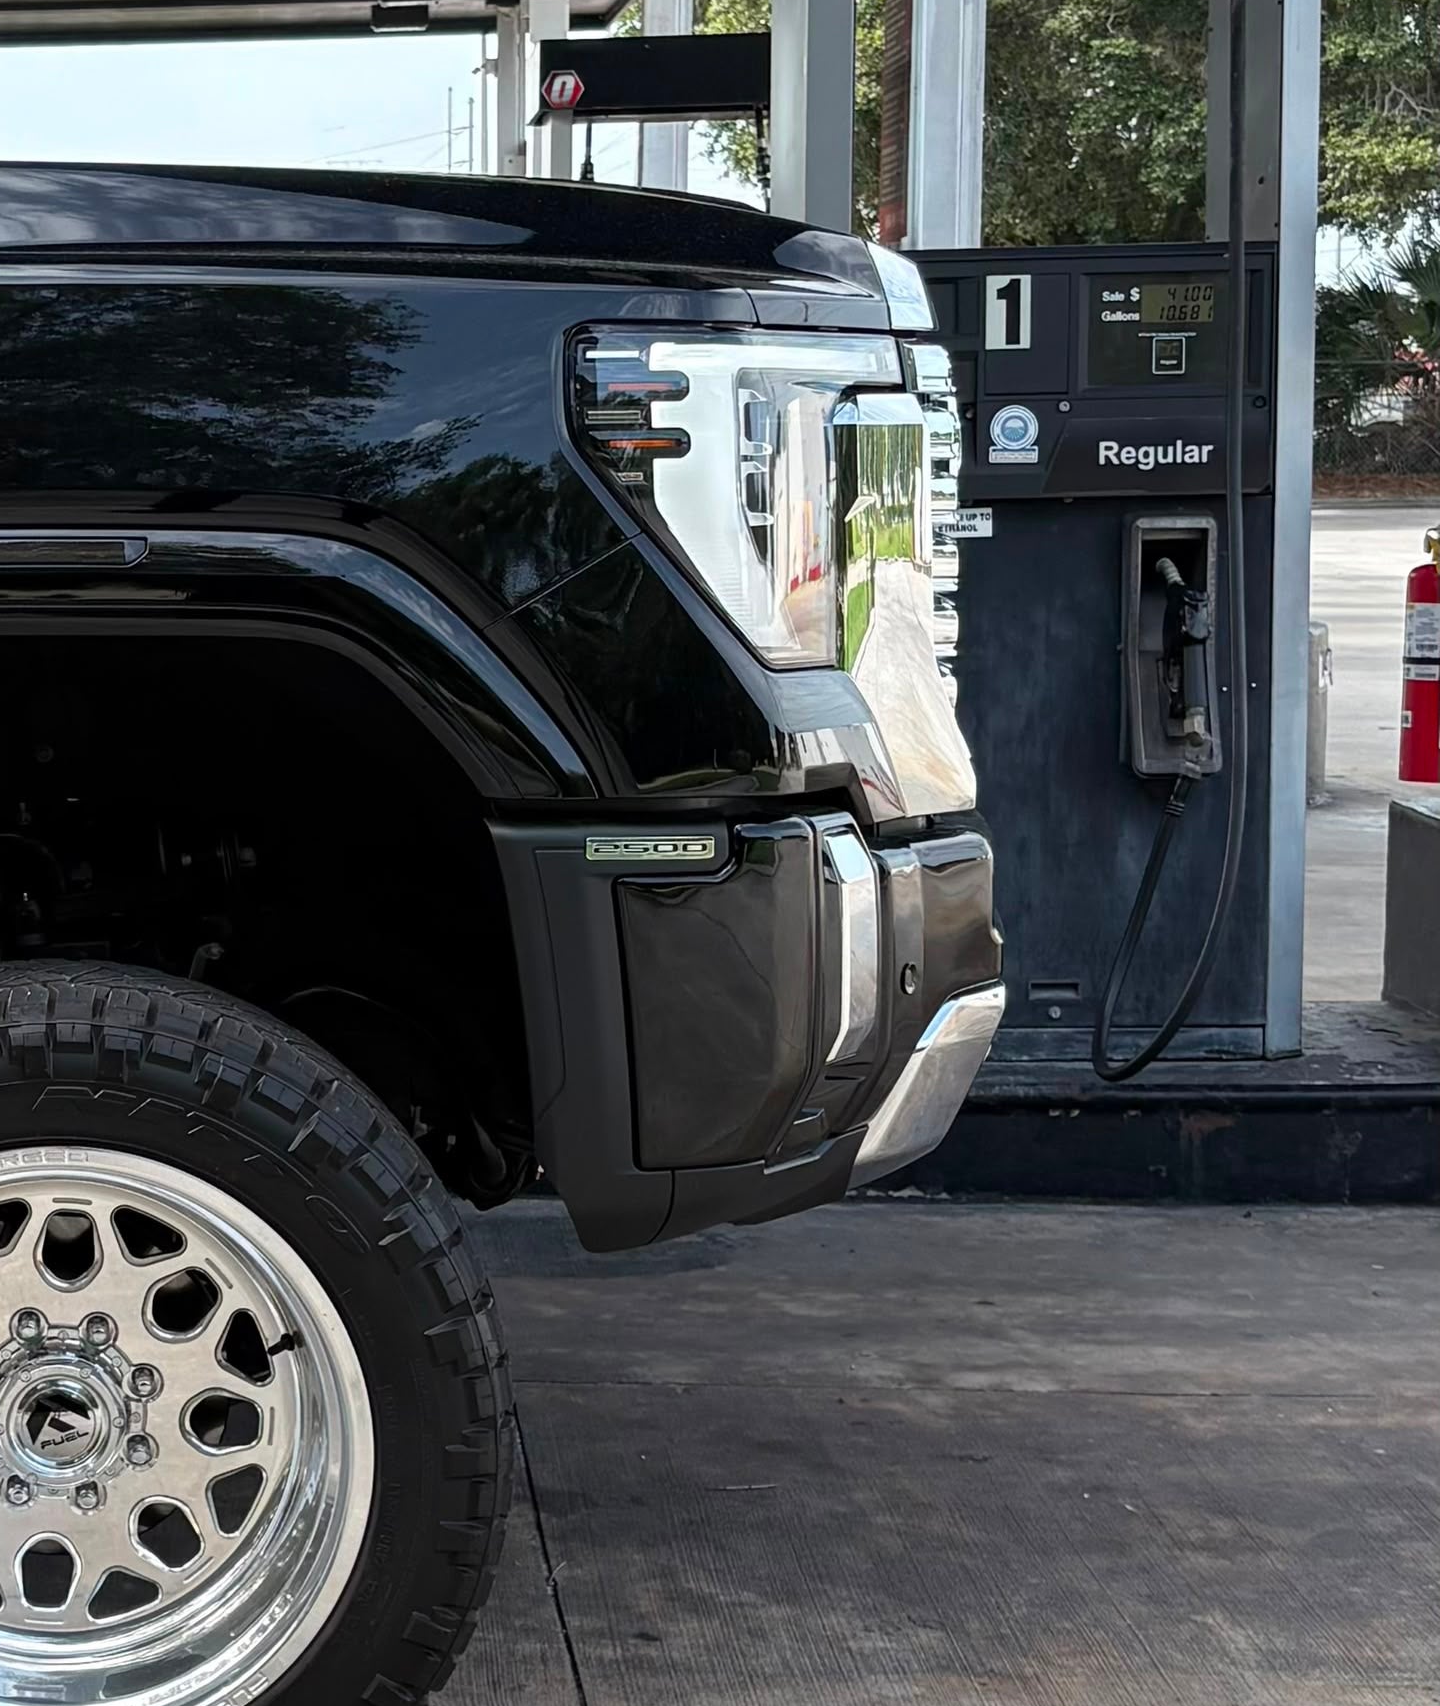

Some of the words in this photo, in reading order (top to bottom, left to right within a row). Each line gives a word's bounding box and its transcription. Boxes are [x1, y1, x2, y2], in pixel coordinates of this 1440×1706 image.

[1101, 290, 1126, 302] Sale
[1129, 286, 1141, 303] $
[995, 278, 1022, 346] 1
[1100, 310, 1141, 322] Gallons
[1098, 440, 1215, 470] Regular
[965, 512, 978, 522] UP
[980, 512, 991, 521] TO
[592, 843, 708, 854] 2500
[40, 1430, 90, 1451] FUEL
